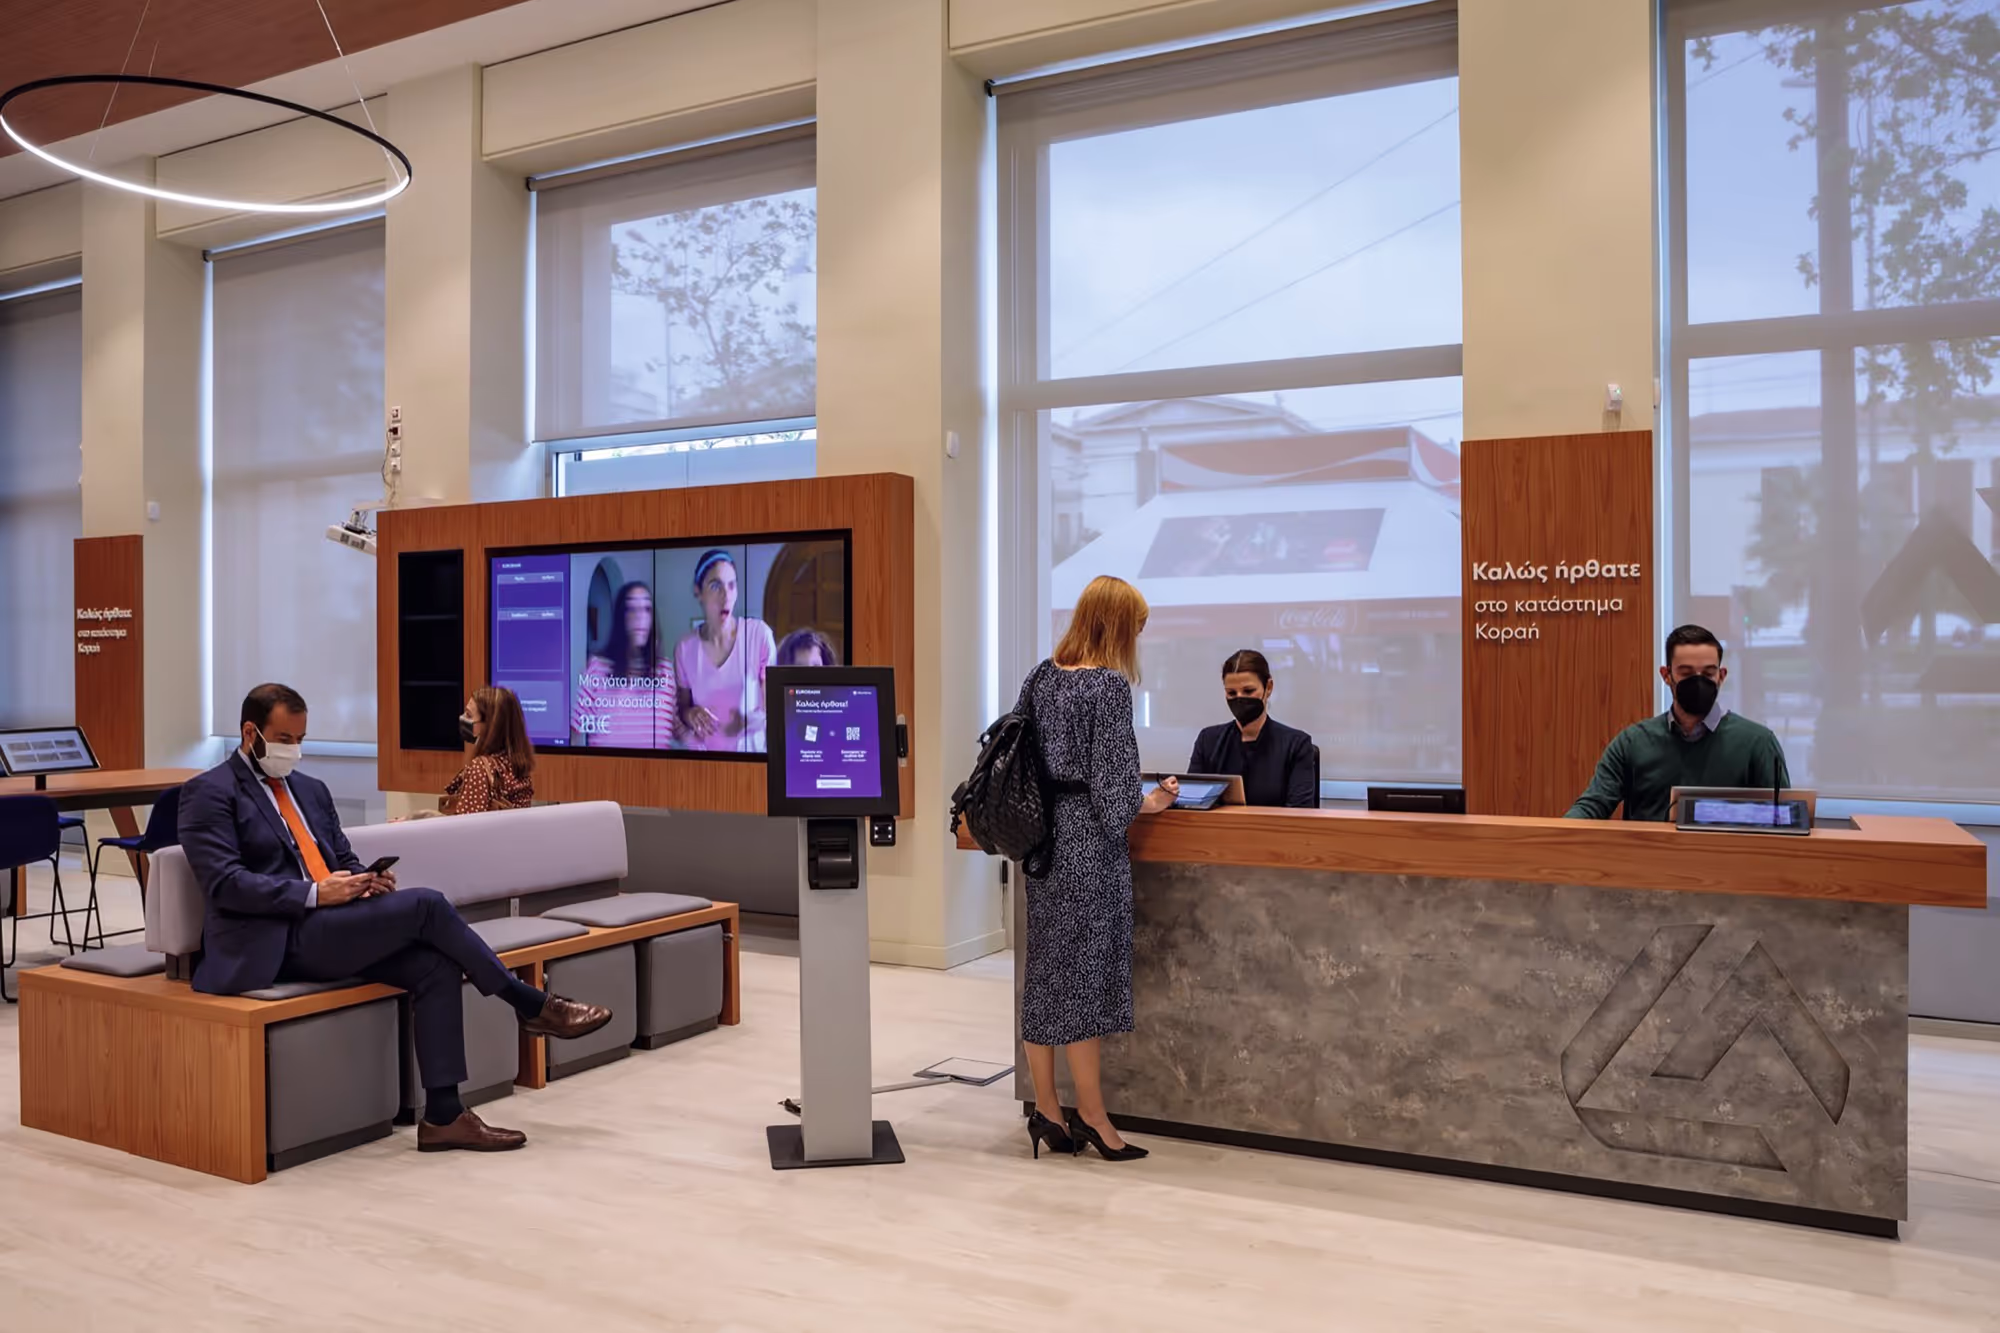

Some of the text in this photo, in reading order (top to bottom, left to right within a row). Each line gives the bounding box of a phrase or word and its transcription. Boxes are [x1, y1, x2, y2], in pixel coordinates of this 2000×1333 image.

[1472, 559, 1641, 584] Καλώς ήρθατε
[1474, 595, 1623, 616] στο κατάστημα
[1475, 622, 1540, 644] Κοραή
[602, 674, 627, 690] γάτα
[630, 674, 669, 691] μπορεί
[595, 698, 615, 708] σου
[795, 700, 820, 708] Καλώς
